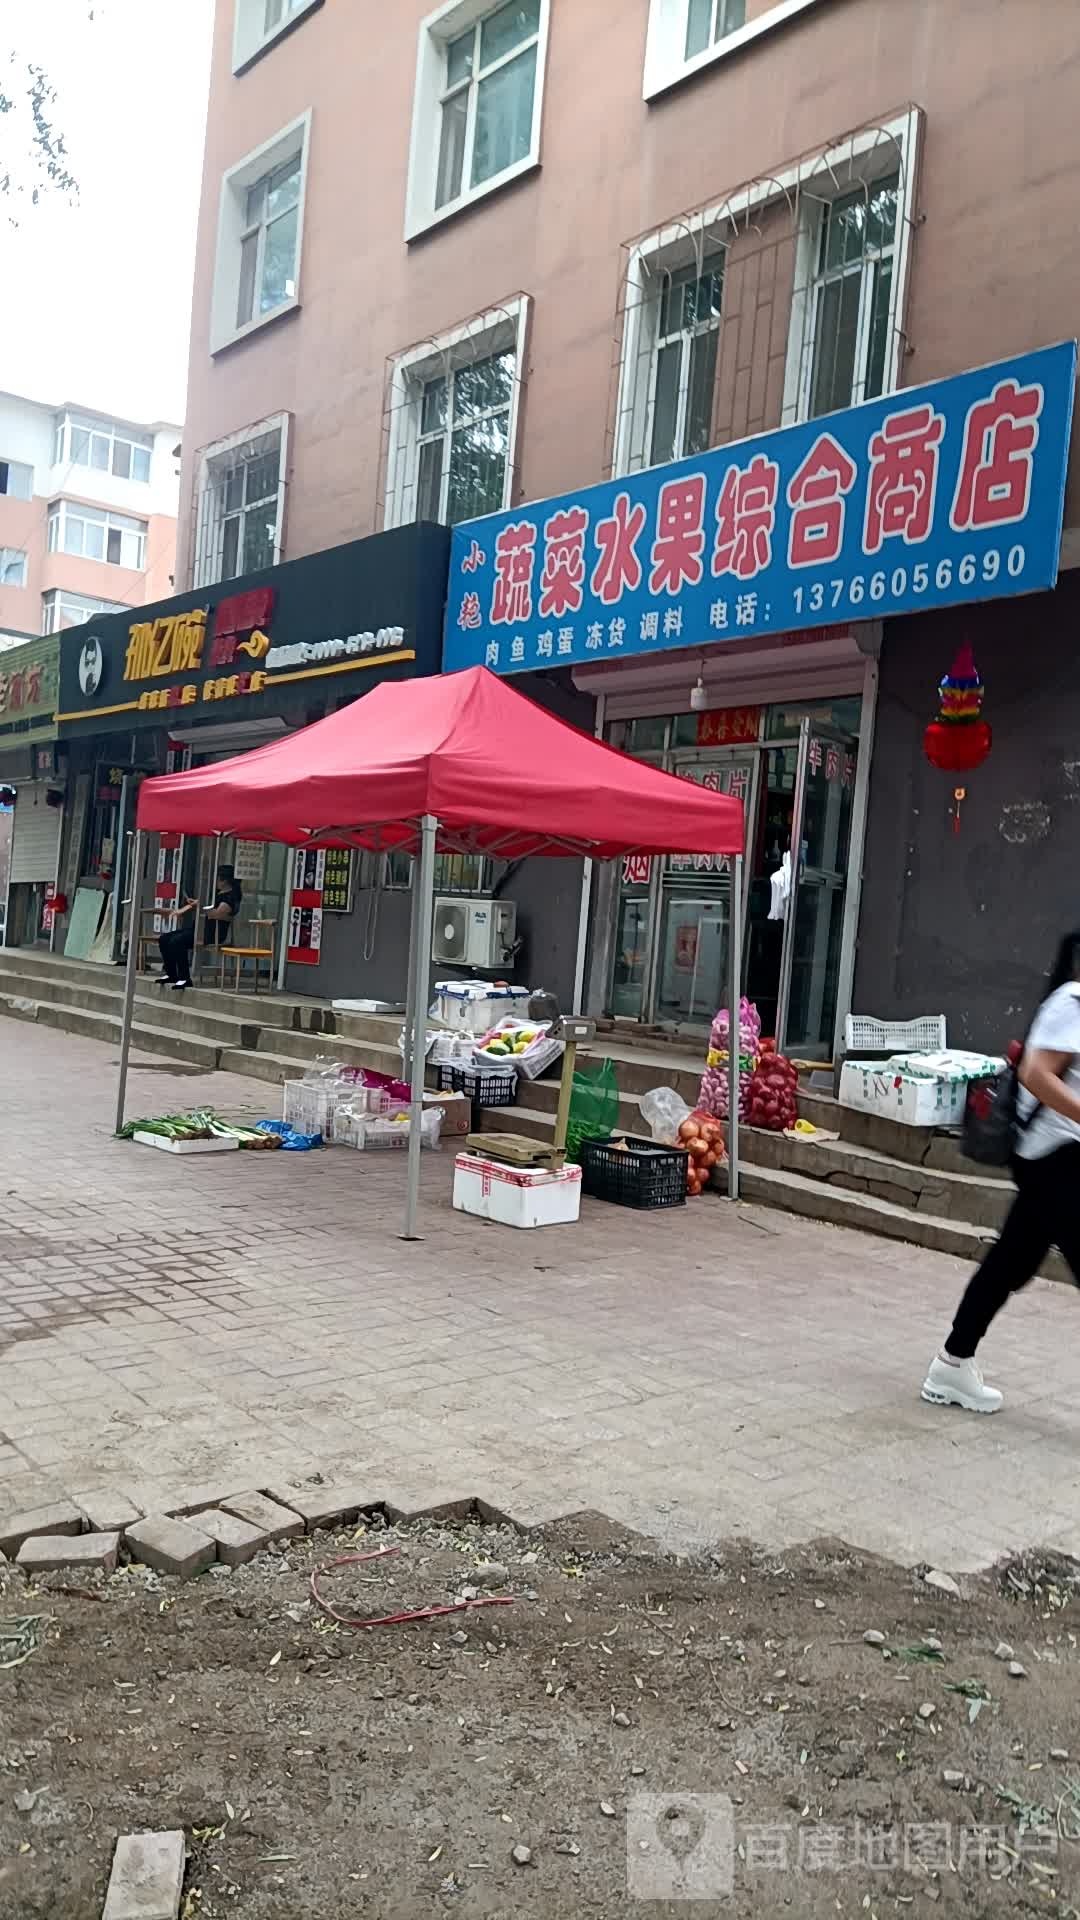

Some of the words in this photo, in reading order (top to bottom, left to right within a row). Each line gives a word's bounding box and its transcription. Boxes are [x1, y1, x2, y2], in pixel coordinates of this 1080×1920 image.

[489, 378, 1044, 625] 蔬菜水果综合商店
[484, 640, 499, 666] 肉
[510, 636, 525, 662] 鱼
[535, 627, 574, 657] 鸡蛋
[585, 617, 626, 650] 冻货
[640, 606, 683, 640] 调料
[793, 545, 1026, 614] 13766056690
